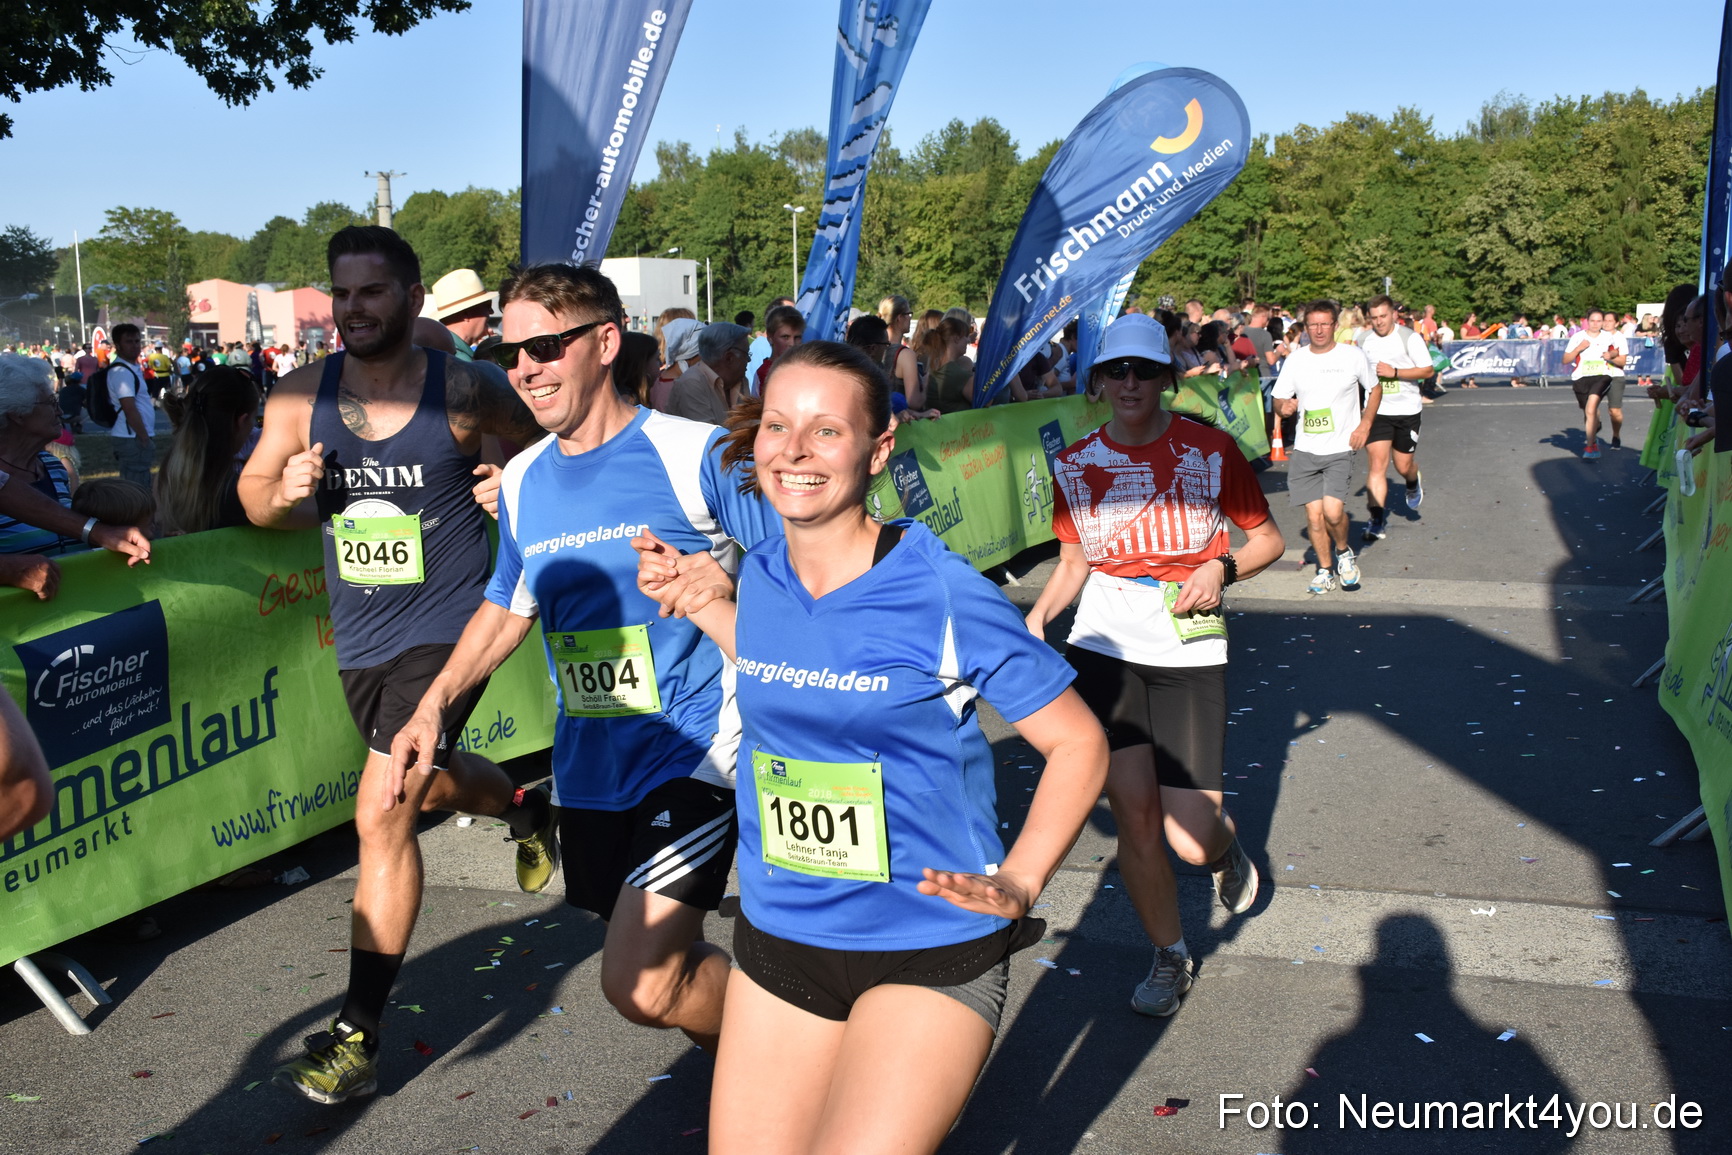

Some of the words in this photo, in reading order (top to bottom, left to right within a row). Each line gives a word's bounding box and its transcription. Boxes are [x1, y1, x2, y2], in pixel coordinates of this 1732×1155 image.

[566, 9, 667, 266] scher-automobile.de
[1117, 202, 1157, 239] Druck
[1156, 179, 1183, 206] und
[1182, 137, 1233, 181] Medien
[1013, 161, 1173, 304] Frischmann
[981, 295, 1072, 393] www.frischmann-net.de
[1461, 355, 1521, 367] Fischer
[1304, 416, 1329, 428] 2095
[326, 464, 425, 491] DENIM
[362, 457, 380, 467] The
[922, 486, 964, 537] enlauf
[1112, 506, 1134, 516] 26.22
[342, 540, 409, 566] 2046
[349, 565, 378, 573] Kracheel
[1192, 618, 1216, 626] Mederer
[56, 649, 150, 698] Fischer
[566, 658, 640, 694] 1804
[735, 656, 889, 692] energiegeladen
[65, 672, 143, 709] AUTOMOBILE
[581, 693, 602, 703] Schöll
[604, 693, 627, 702] Franz
[82, 710, 103, 731] und
[105, 703, 124, 717] das
[123, 685, 163, 710] Lächeln
[109, 712, 135, 736] fährt
[0, 666, 279, 862] menlauf
[766, 772, 802, 788] firmenlauf
[808, 787, 833, 799] 2018
[211, 770, 364, 848] www.firmenla
[770, 796, 859, 847] 1801
[4, 810, 133, 893] eumarkt
[786, 840, 817, 856] Lehner
[819, 846, 848, 861] Tanja
[787, 852, 849, 868] Seitz&Braun-Team
